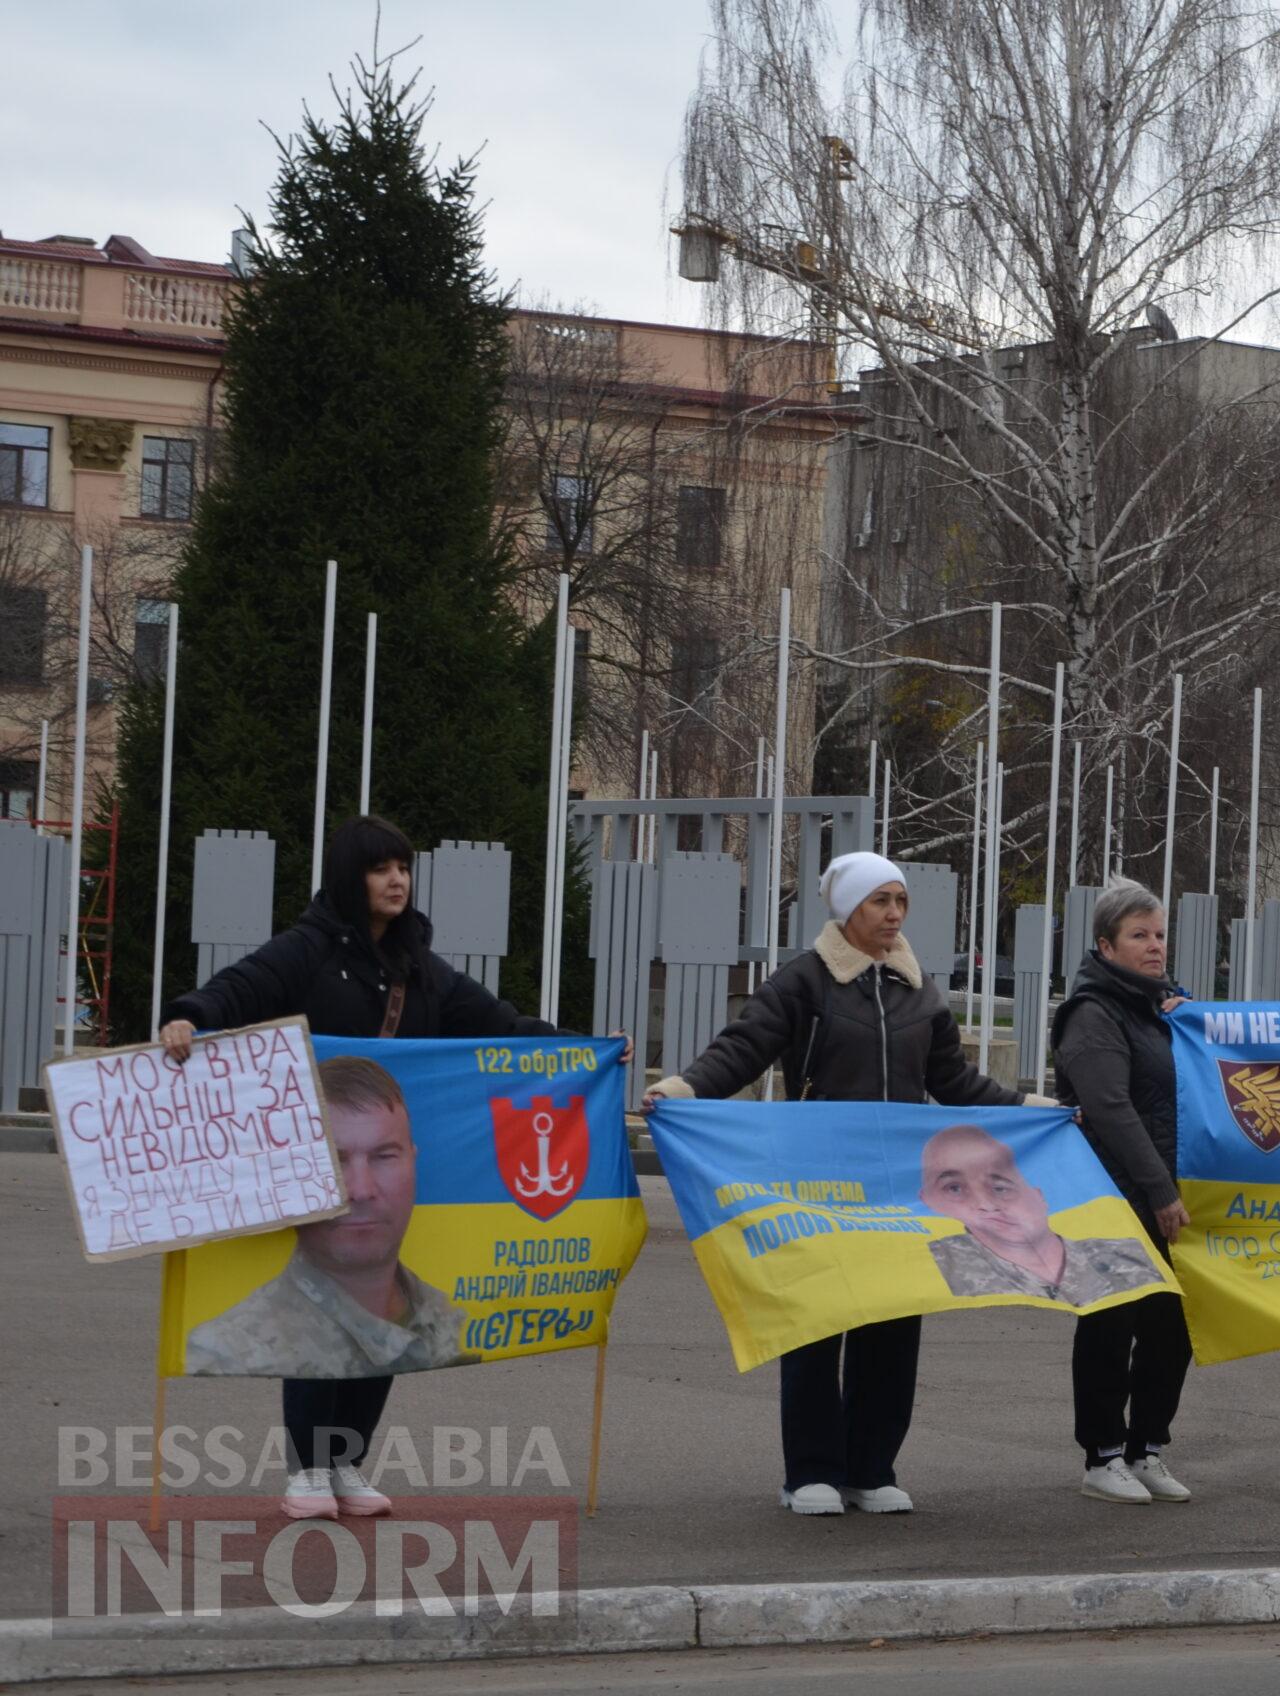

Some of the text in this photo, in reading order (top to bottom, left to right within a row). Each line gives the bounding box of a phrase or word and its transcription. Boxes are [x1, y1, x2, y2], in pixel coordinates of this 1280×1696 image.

[1203, 1012, 1244, 1044] МИ
[97, 1028, 298, 1098] МОЯ ВІРА
[475, 1047, 598, 1079] 122 обрТРО
[69, 1064, 304, 1143] СИЛЬНІШ ЗА
[101, 1102, 325, 1180] НЕВІДОМІСТЬ
[83, 1142, 333, 1219] Я ЗНАЙДУ ТЕБЕ
[108, 1208, 158, 1249] ДЕ
[195, 1193, 248, 1232] ТИ
[255, 1183, 296, 1221] НЕ
[742, 1211, 834, 1259] ПОЛОН
[495, 1237, 591, 1267] РАДОЛОВ
[1206, 1230, 1260, 1259] Ігор
[453, 1267, 621, 1302] АНДРІЙ ІВАНОВИЧ
